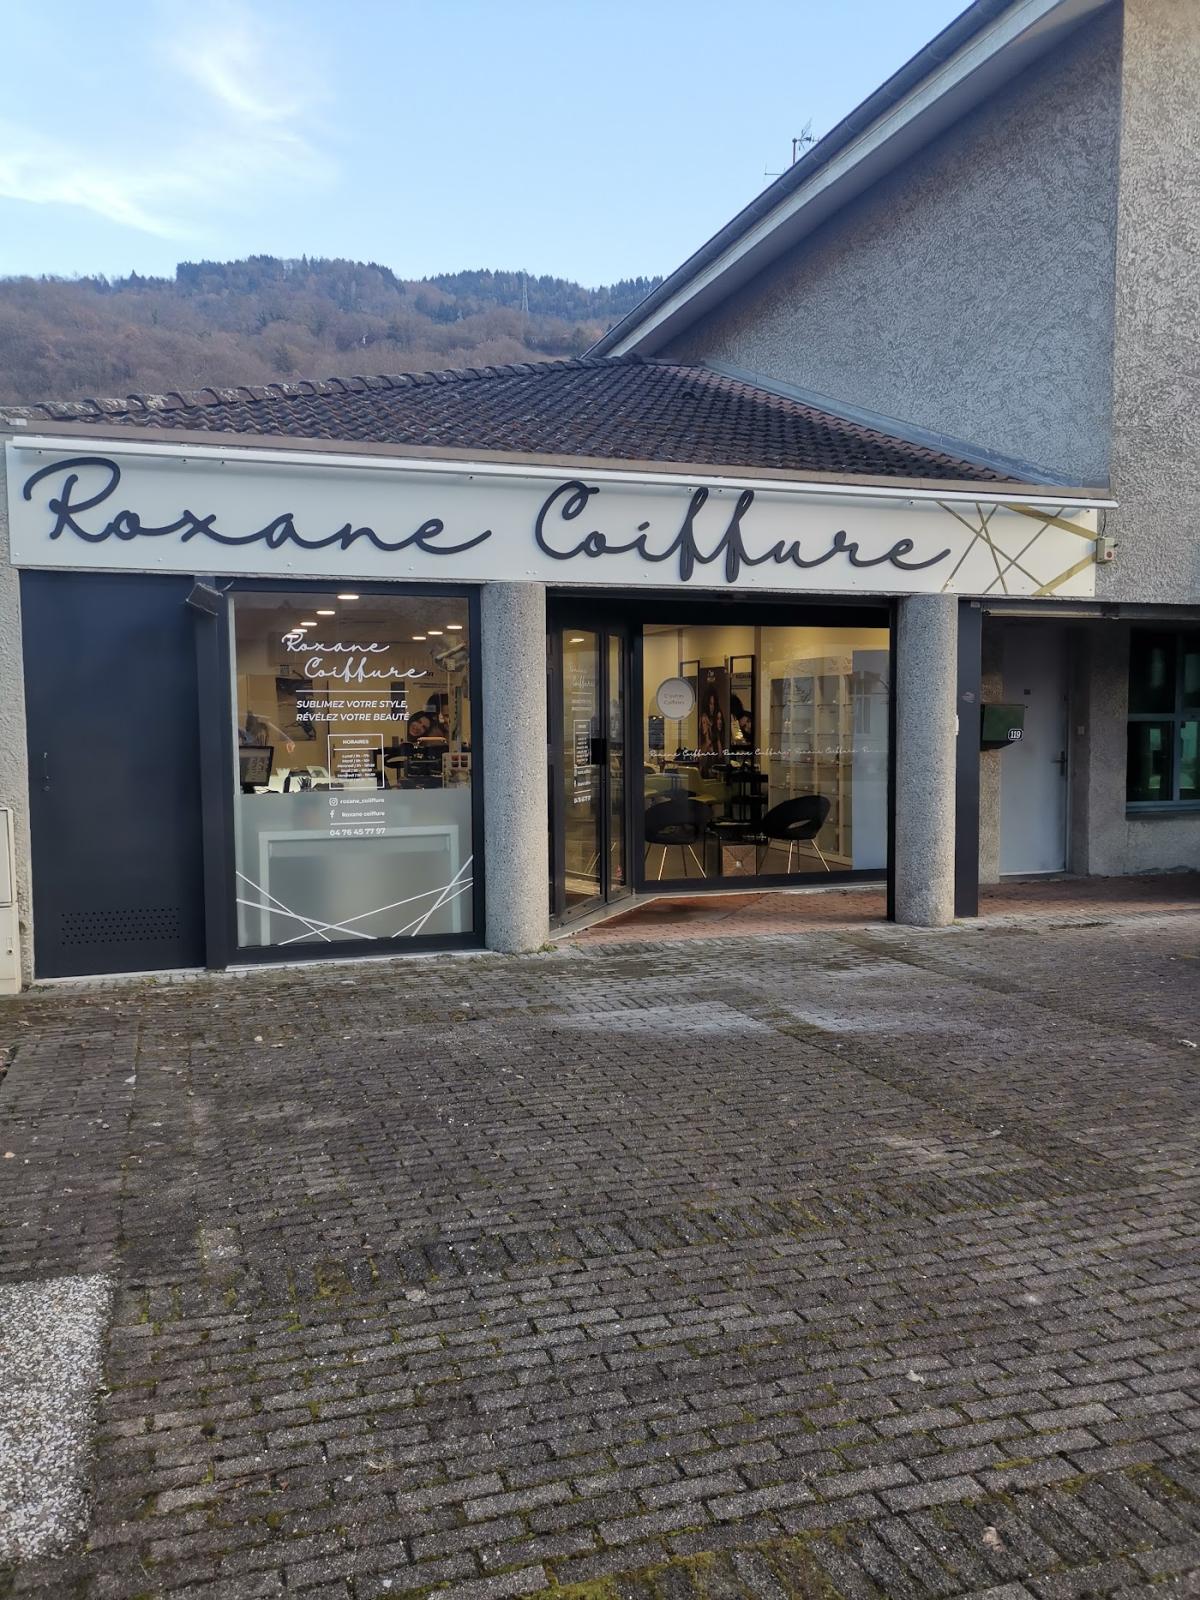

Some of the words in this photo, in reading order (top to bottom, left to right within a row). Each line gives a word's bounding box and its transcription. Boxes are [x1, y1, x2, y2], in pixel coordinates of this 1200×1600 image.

[23, 457, 492, 555] Roxane
[535, 480, 951, 583] Coiffure
[281, 632, 390, 653] Roxane
[304, 656, 427, 683] Coiffure
[296, 700, 344, 708] SUBLIMEZ
[346, 700, 377, 708] VOTRE
[379, 700, 408, 709] STYLE,
[296, 712, 338, 721] RÉVÉLEZ
[341, 713, 372, 721] VOTRE
[373, 712, 410, 721] BEAUTÉ
[1010, 731, 1021, 739] 119
[375, 827, 386, 835] 97
